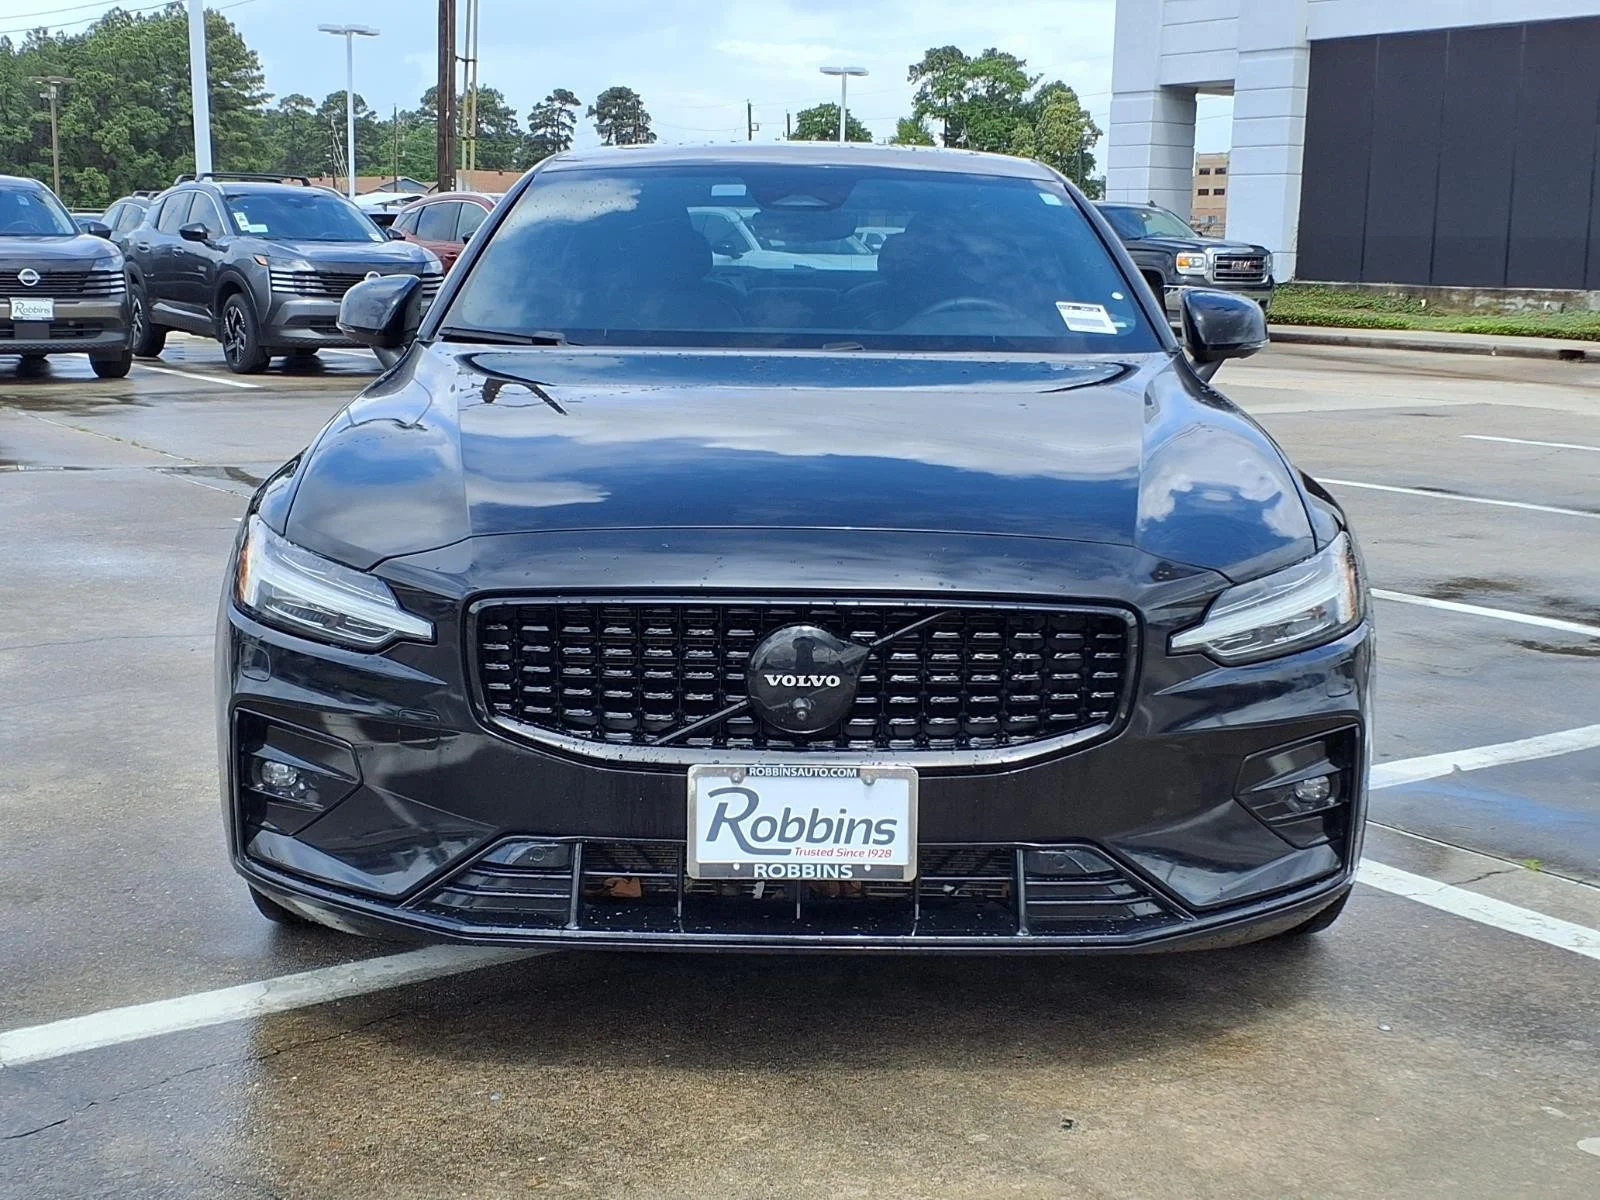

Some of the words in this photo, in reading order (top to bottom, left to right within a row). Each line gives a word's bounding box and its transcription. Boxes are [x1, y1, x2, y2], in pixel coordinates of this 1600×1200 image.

[14, 302, 50, 315] Robbins
[764, 674, 840, 687] VOLVO
[749, 767, 857, 777] ROBBINSAUTO.COM
[705, 786, 898, 856] Robbins
[795, 847, 834, 857] Trusted
[836, 848, 865, 857] Since
[867, 849, 892, 858] 1928
[753, 863, 853, 879] ROBBINS
